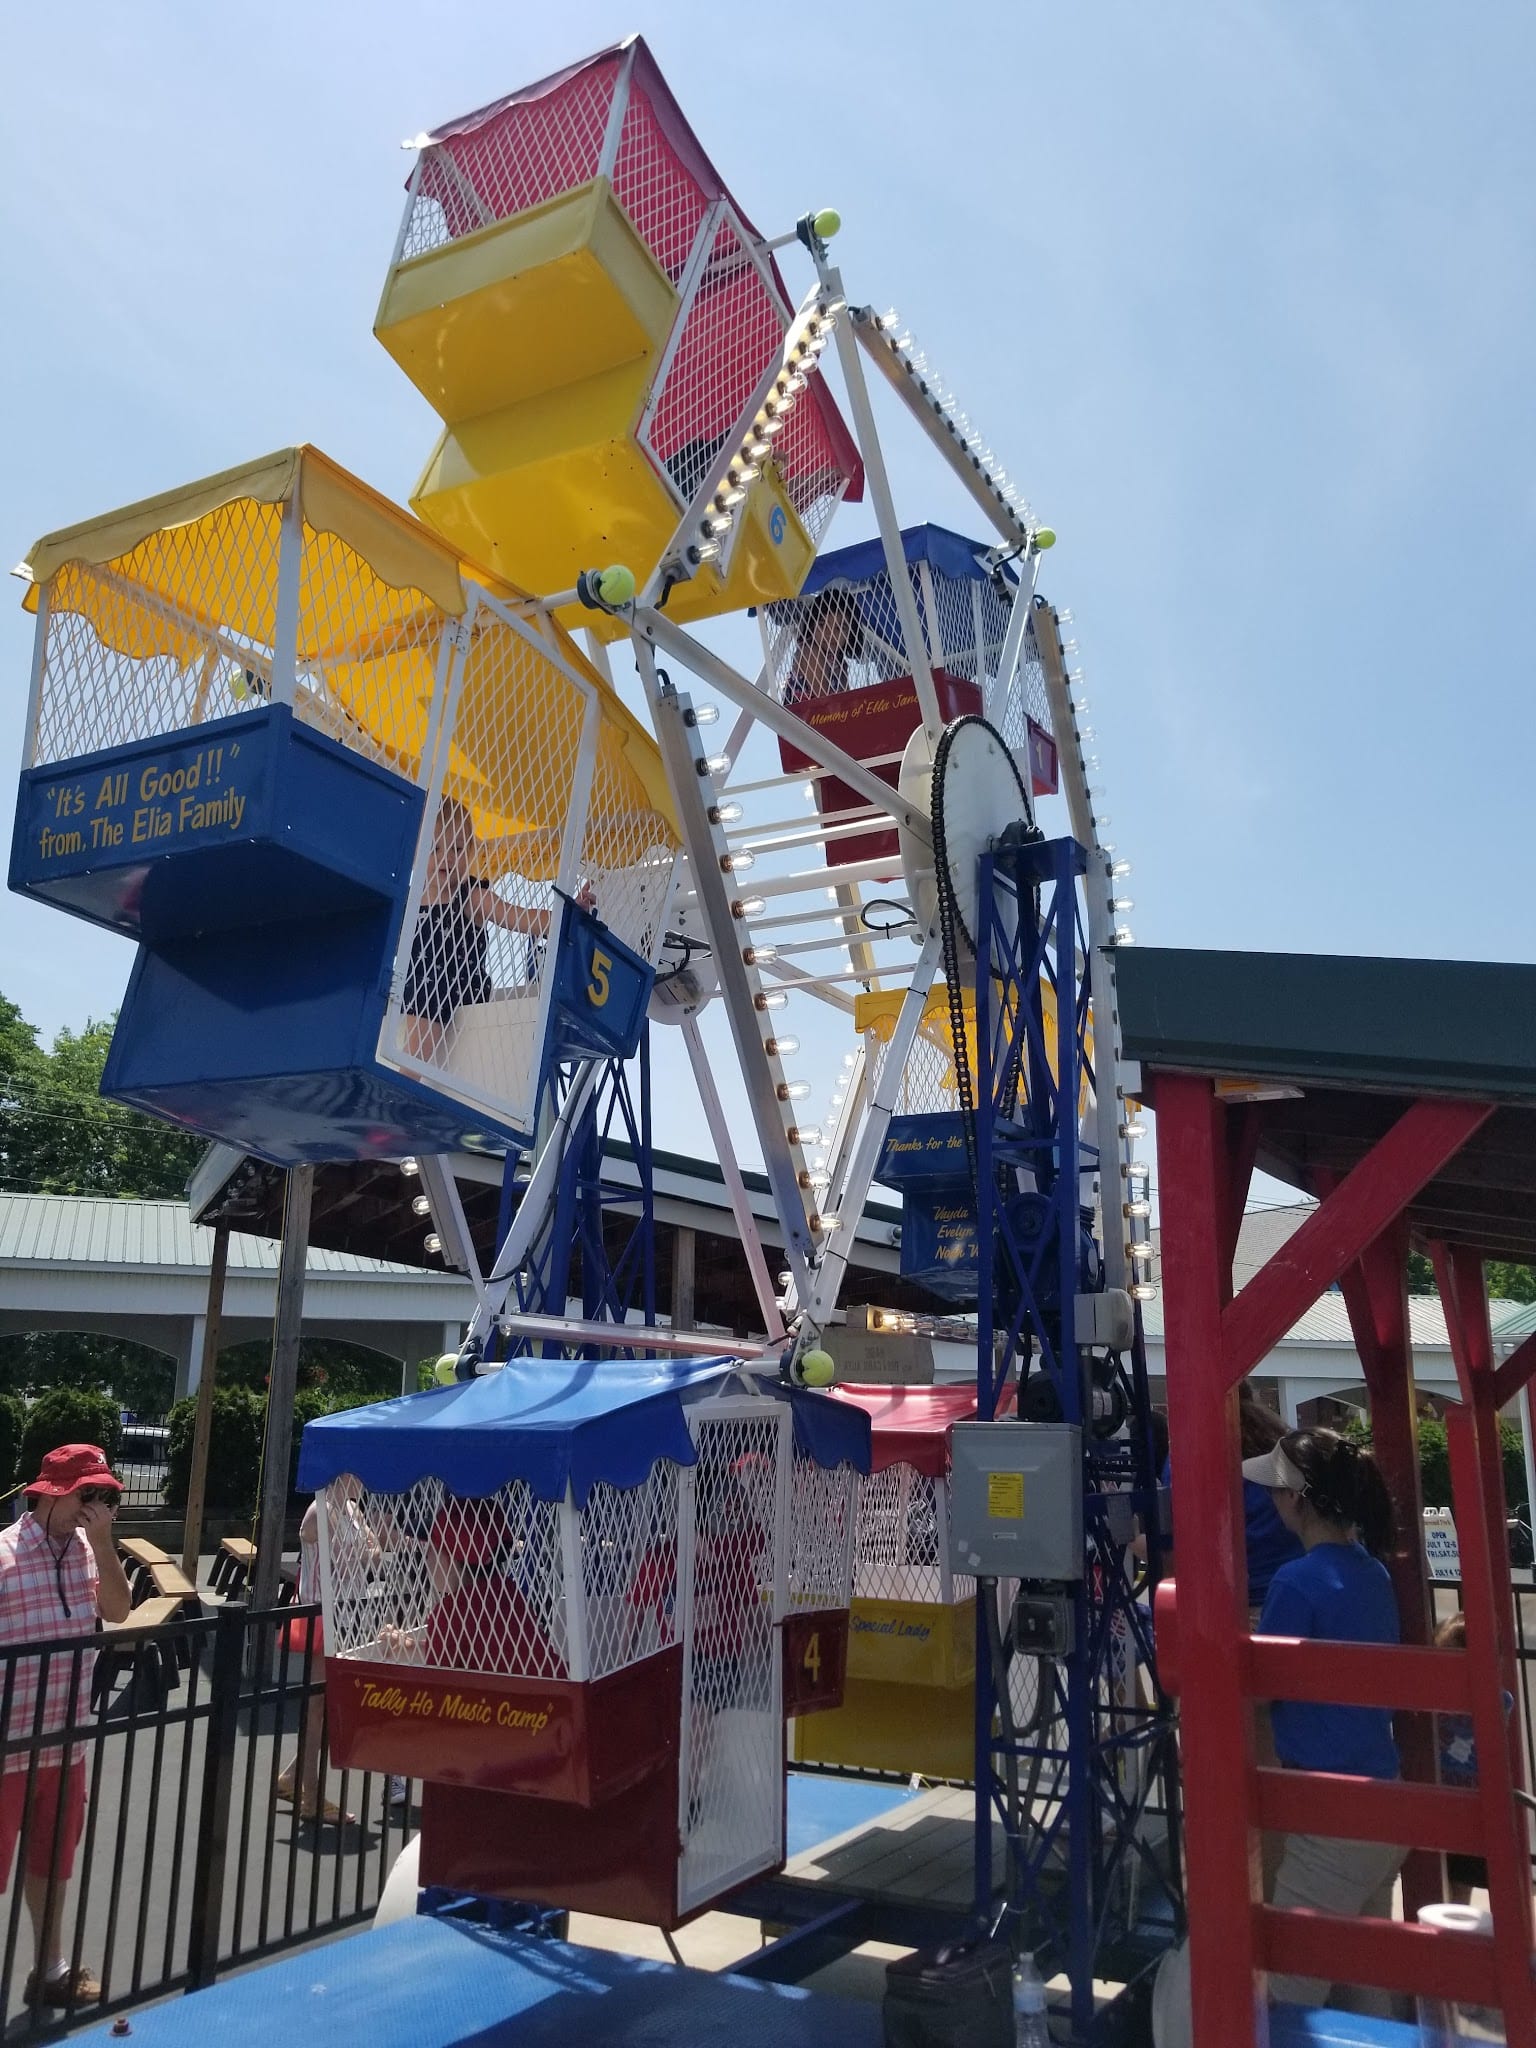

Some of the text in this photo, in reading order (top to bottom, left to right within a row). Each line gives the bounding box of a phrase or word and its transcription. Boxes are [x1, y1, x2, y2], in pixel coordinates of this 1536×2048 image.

[769, 504, 787, 545] 6
[810, 709, 848, 726] Memory
[851, 706, 864, 719] of
[95, 772, 129, 810] All
[90, 817, 123, 849] The
[178, 787, 246, 832] Family
[587, 947, 612, 1006] 5
[886, 1135, 963, 1152] Thanks for the
[937, 1224, 975, 1240] Evelyn
[1432, 1531, 1447, 1539] OPEN
[851, 1615, 897, 1635] Special
[804, 1632, 821, 1683] 4
[409, 1690, 434, 1716] Ho
[438, 1694, 491, 1724] Music
